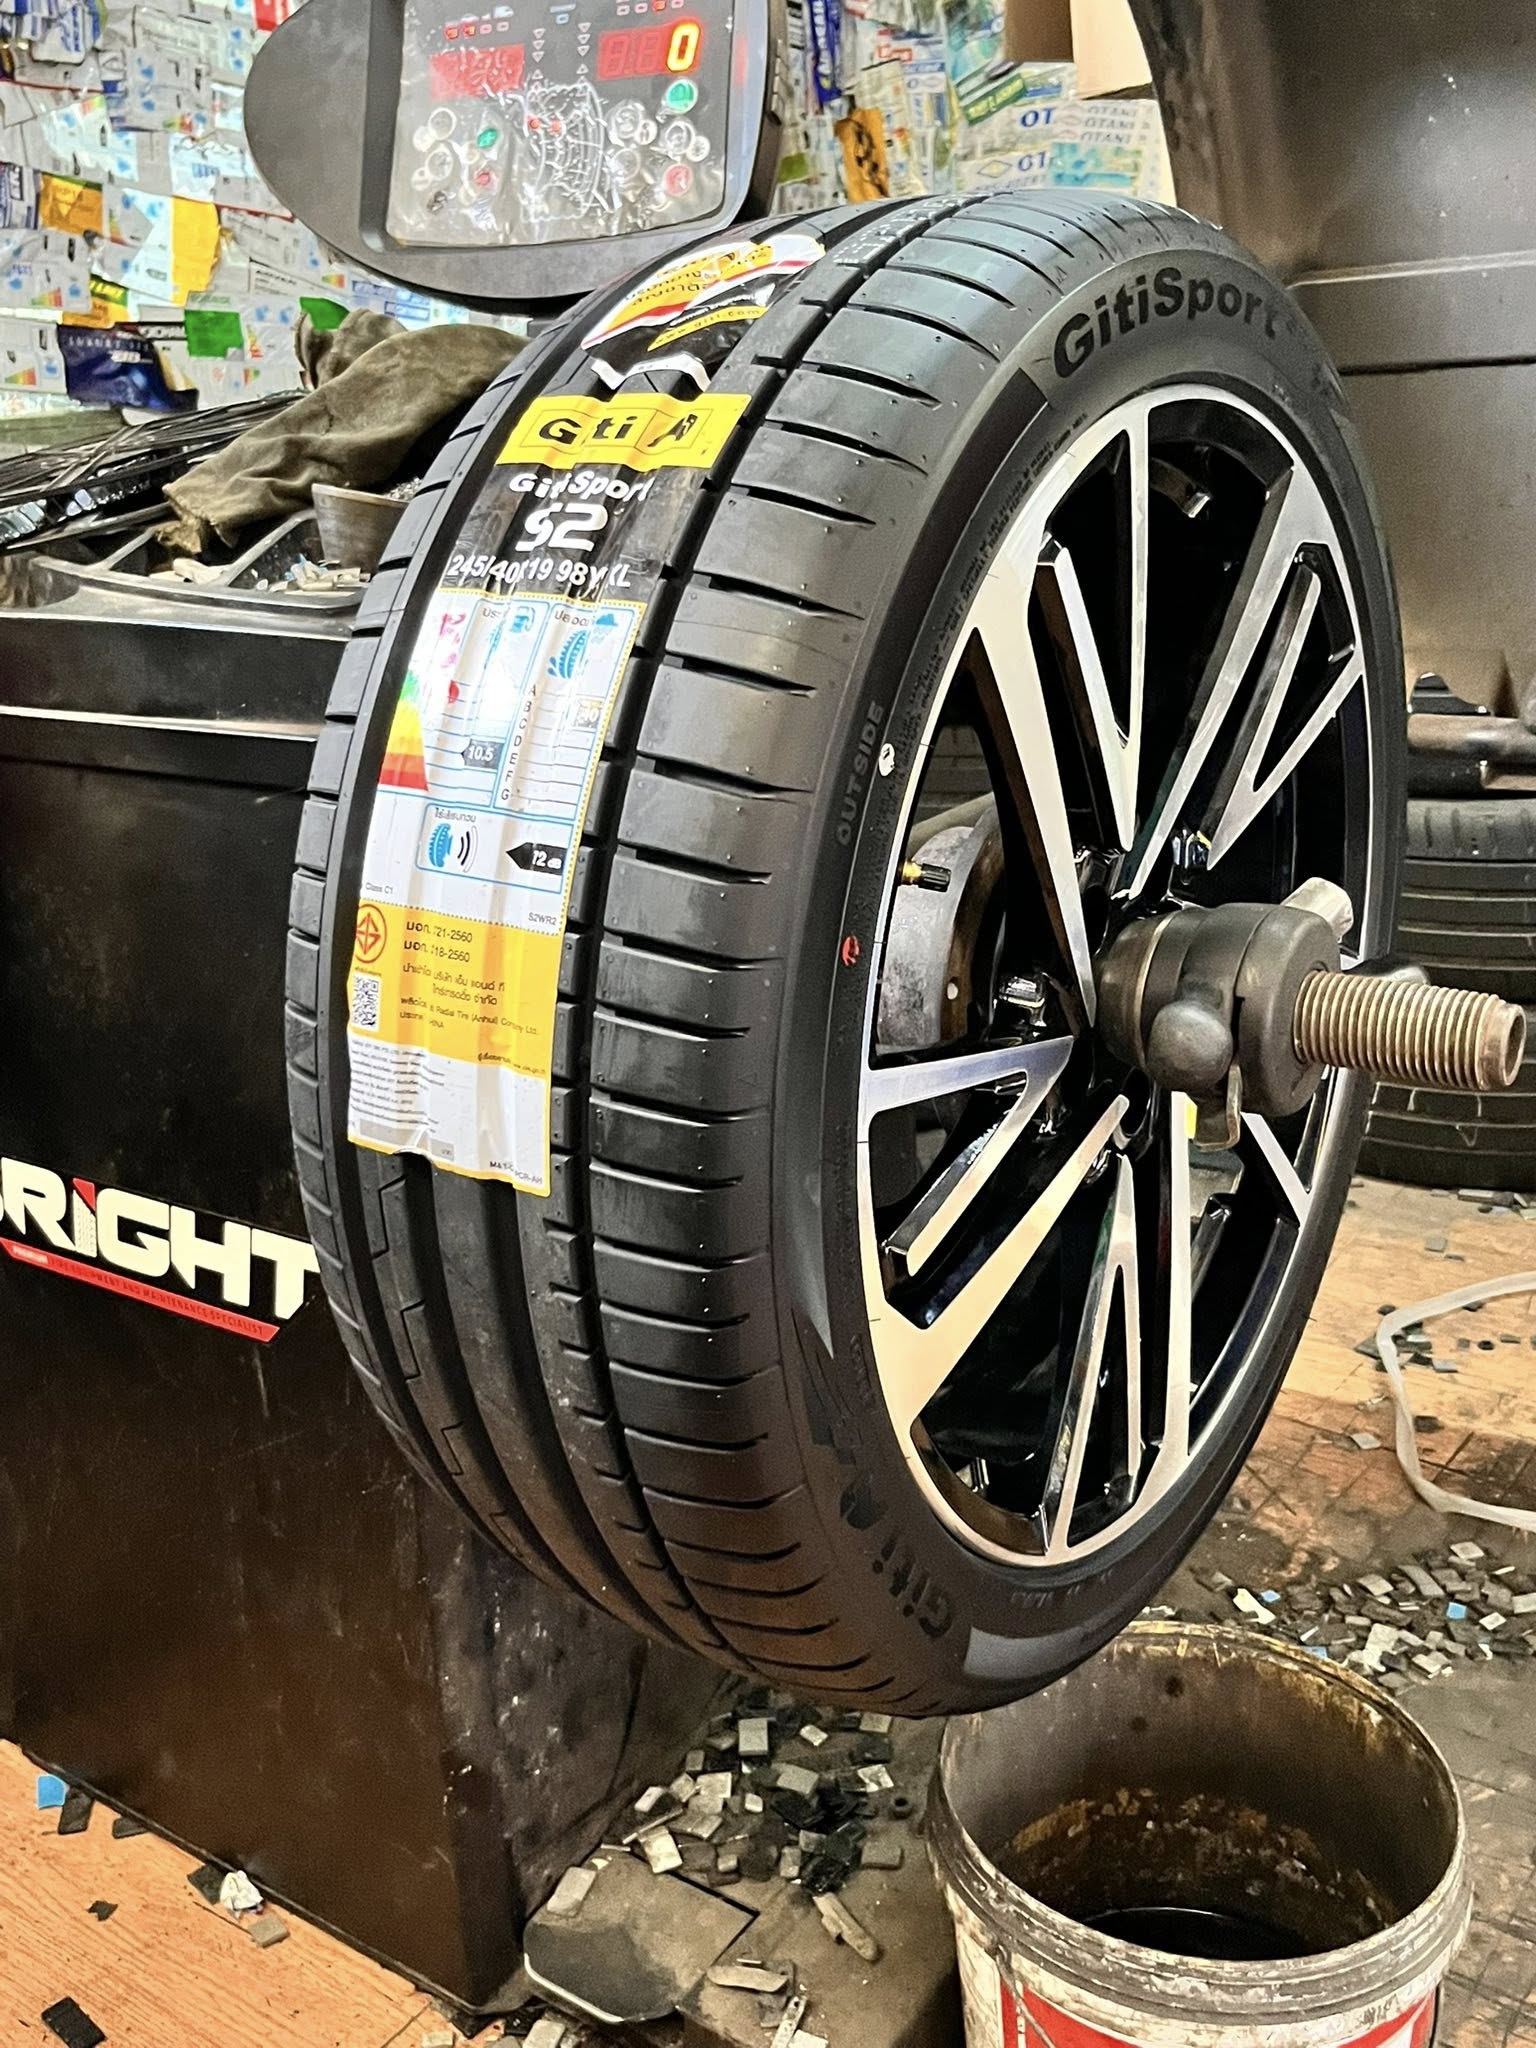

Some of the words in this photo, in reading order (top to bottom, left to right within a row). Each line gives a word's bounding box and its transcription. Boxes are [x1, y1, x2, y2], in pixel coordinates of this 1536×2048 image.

[666, 20, 701, 73] 0
[1053, 266, 1278, 379] GitiSport
[538, 415, 639, 446] Gti
[514, 502, 609, 553] S2
[467, 743, 495, 762] 10.5
[835, 700, 884, 846] OUTSIDE
[0, 1157, 320, 1320] RIGHT
[209, 1309, 265, 1337] SPECIALIST
